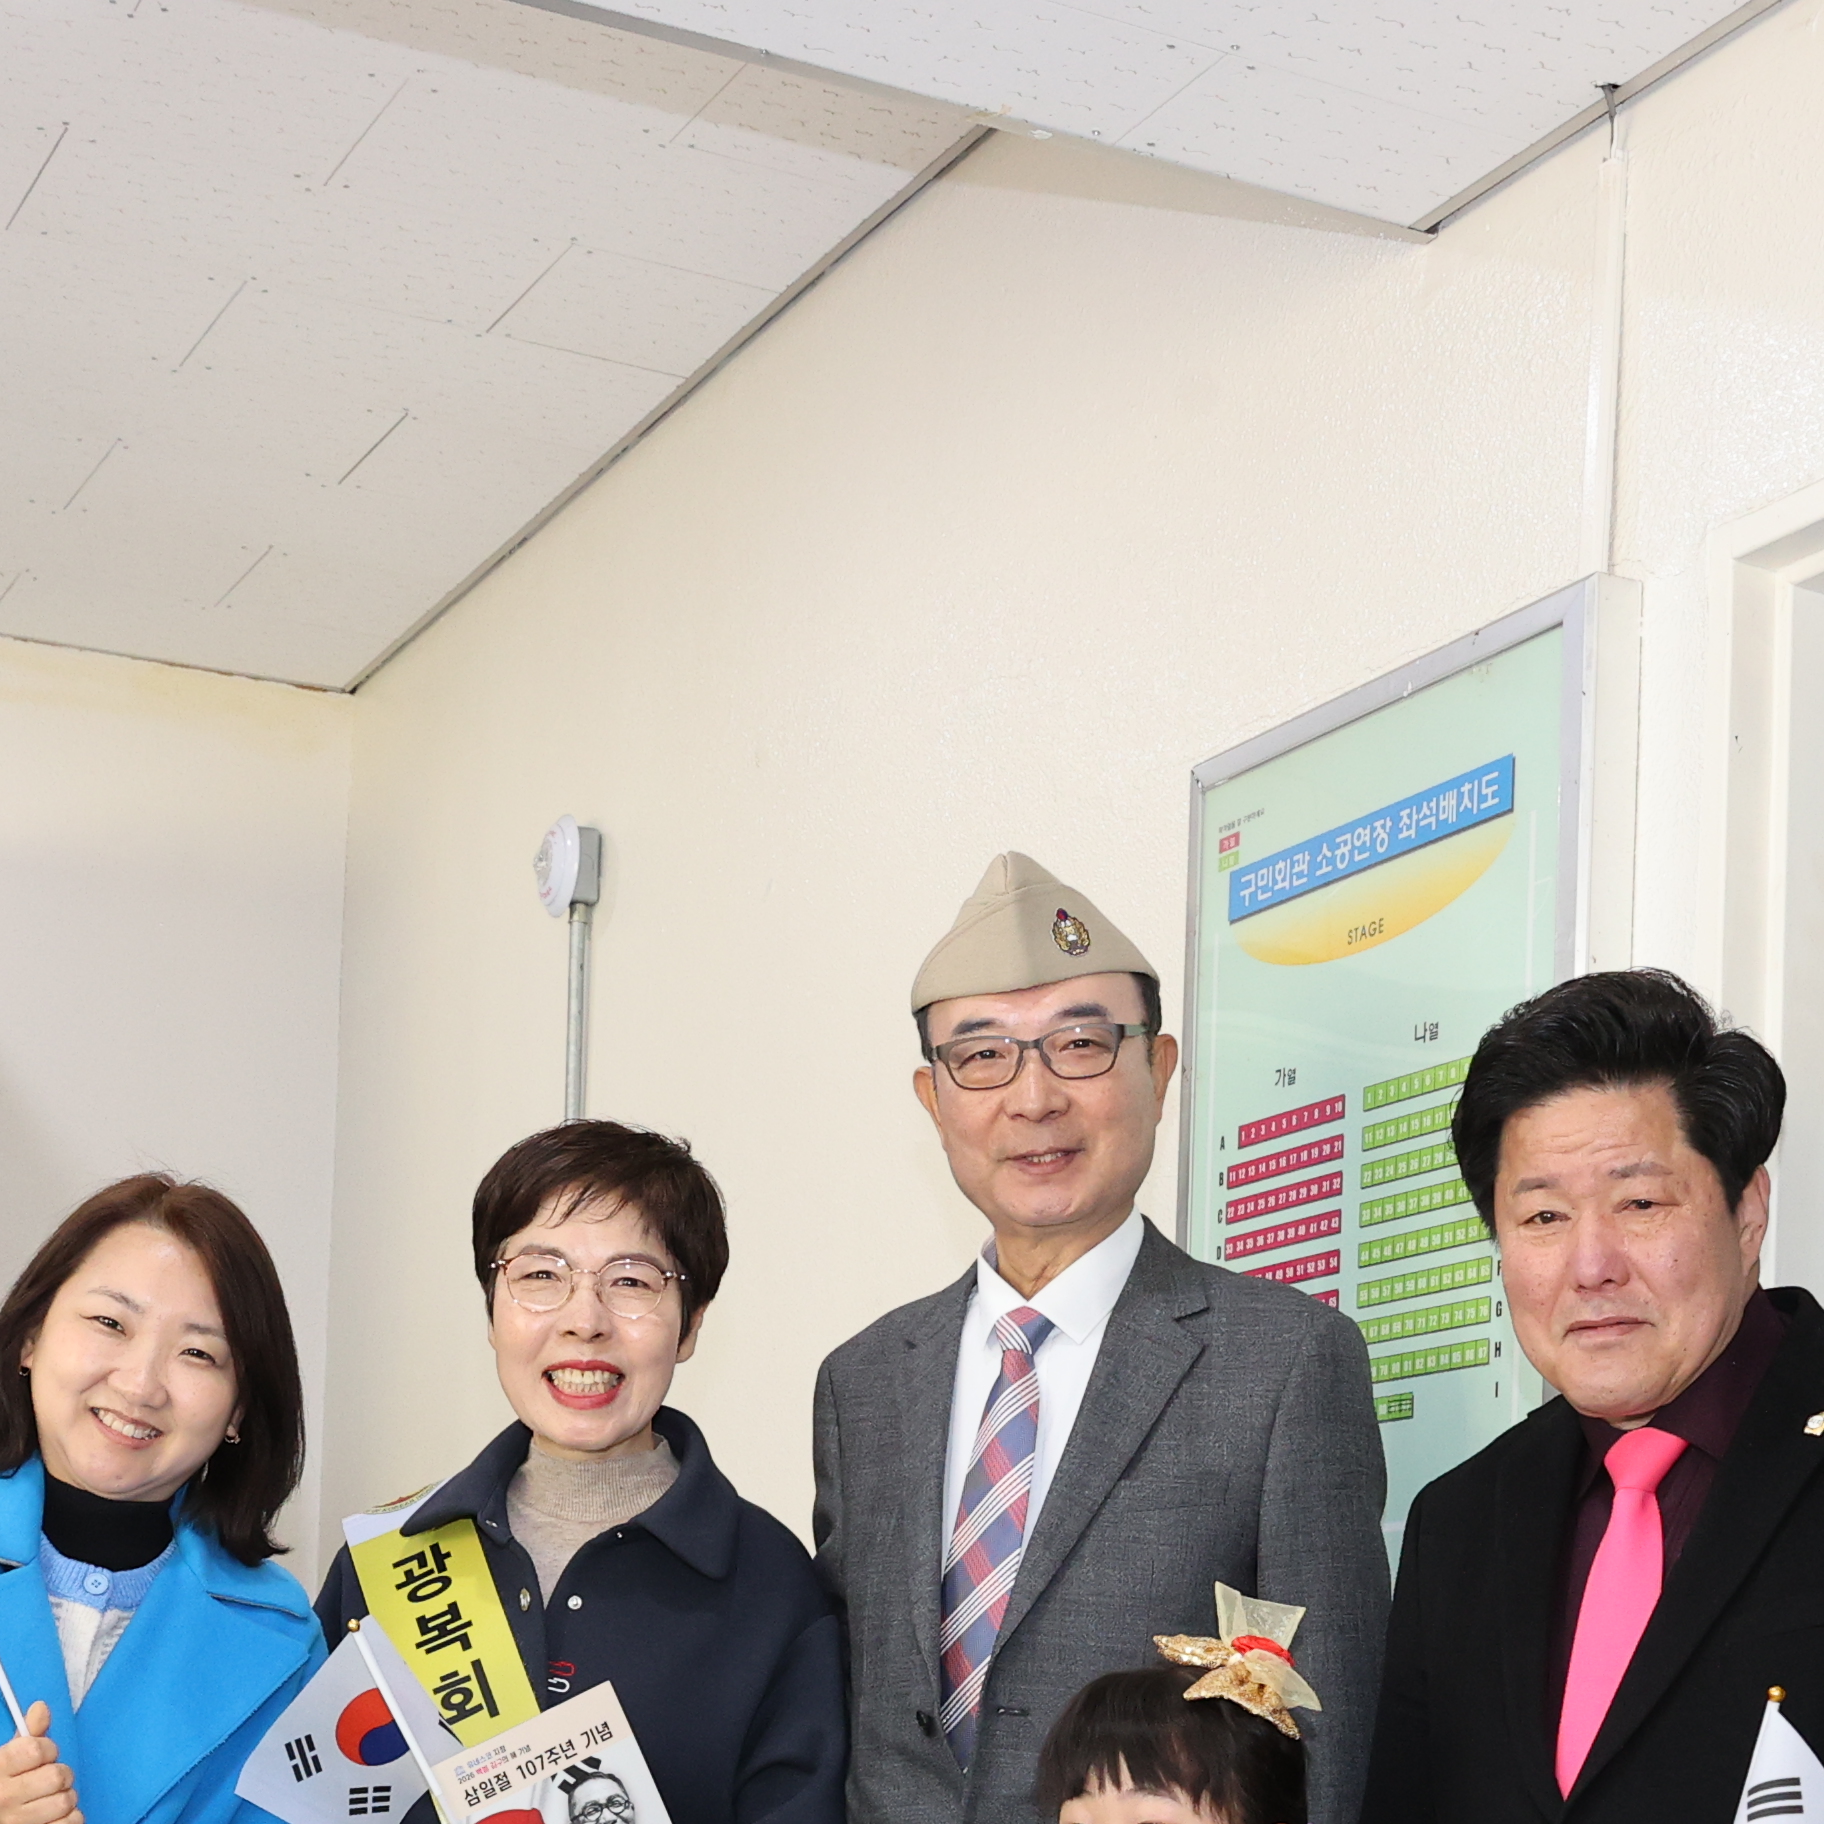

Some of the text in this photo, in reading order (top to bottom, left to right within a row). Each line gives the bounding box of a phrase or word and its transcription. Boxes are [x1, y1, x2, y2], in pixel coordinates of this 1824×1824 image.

[1239, 853, 1310, 907] 구민회관
[1315, 820, 1392, 877] 소공연장
[1399, 770, 1500, 841] 좌석배치도
[1347, 917, 1385, 945] STAGE
[1414, 1021, 1439, 1043] 나열
[1275, 1067, 1296, 1087] 가열
[1335, 1101, 1342, 1112] 10
[1229, 1172, 1235, 1182] 11
[1239, 1169, 1245, 1179] 12
[1248, 1166, 1255, 1176] 13
[1259, 1163, 1266, 1173] 14
[1269, 1160, 1276, 1170] 15
[1279, 1157, 1286, 1167] 16
[1290, 1154, 1297, 1164] 17
[1301, 1150, 1308, 1161] 18
[1311, 1147, 1318, 1158] 19
[1322, 1144, 1330, 1155] 20
[1334, 1141, 1341, 1151] 21
[1227, 1207, 1235, 1218] 22
[1238, 1204, 1245, 1215] 23
[1247, 1202, 1254, 1212] 24
[1279, 1193, 1286, 1204] 27
[1310, 1184, 1318, 1195] 30
[1322, 1181, 1330, 1192] 31
[1333, 1178, 1340, 1189] 32
[1496, 1301, 1502, 1317] G
[1495, 1342, 1501, 1358] H
[392, 1541, 500, 1726] 광복회
[464, 1721, 613, 1807] 삼일절 107주년 기념
[458, 1772, 475, 1784] 2026
